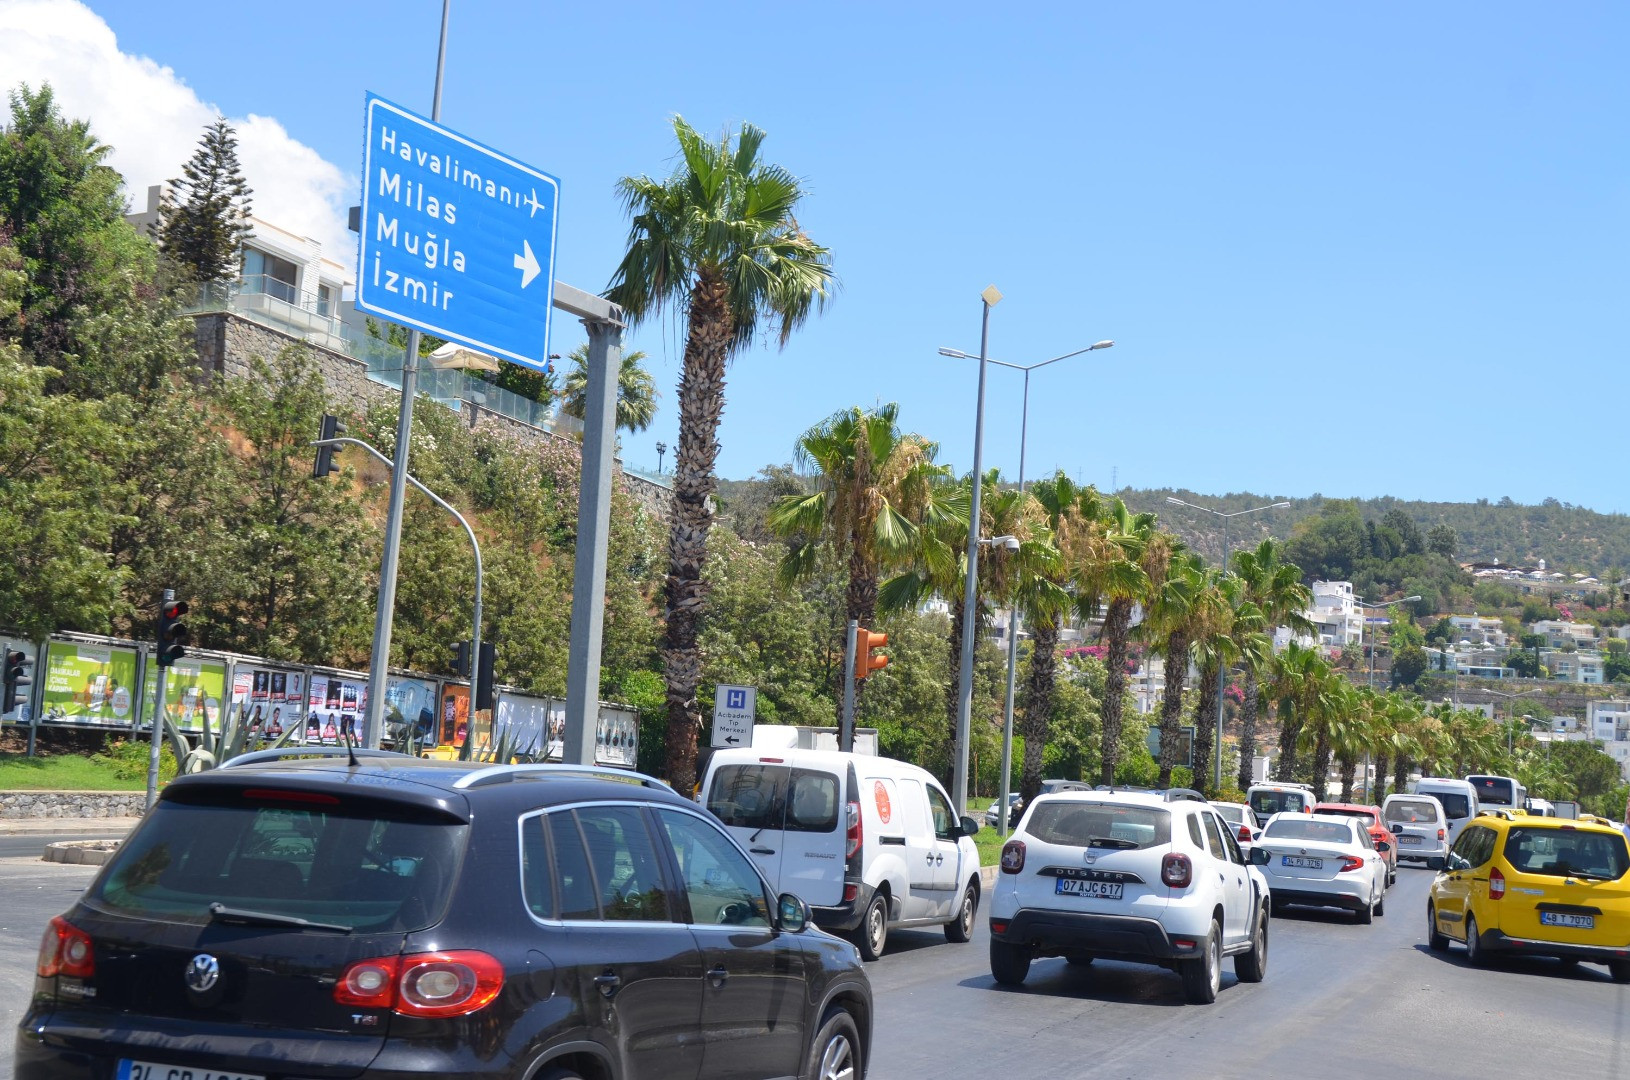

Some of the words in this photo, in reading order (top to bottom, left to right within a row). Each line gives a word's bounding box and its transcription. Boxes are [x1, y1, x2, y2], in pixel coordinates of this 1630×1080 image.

[381, 126, 520, 208] Havalimanı
[379, 167, 457, 225] Milas
[376, 212, 466, 273] Muğla
[730, 692, 742, 707] H
[720, 726, 747, 734] Merkezi
[1056, 869, 1123, 880] DUSTER
[1063, 880, 1077, 891] 07
[1078, 881, 1099, 893] AJC
[1100, 883, 1121, 895] 617
[1546, 913, 1557, 922] 48
[1570, 916, 1592, 925] 7070
